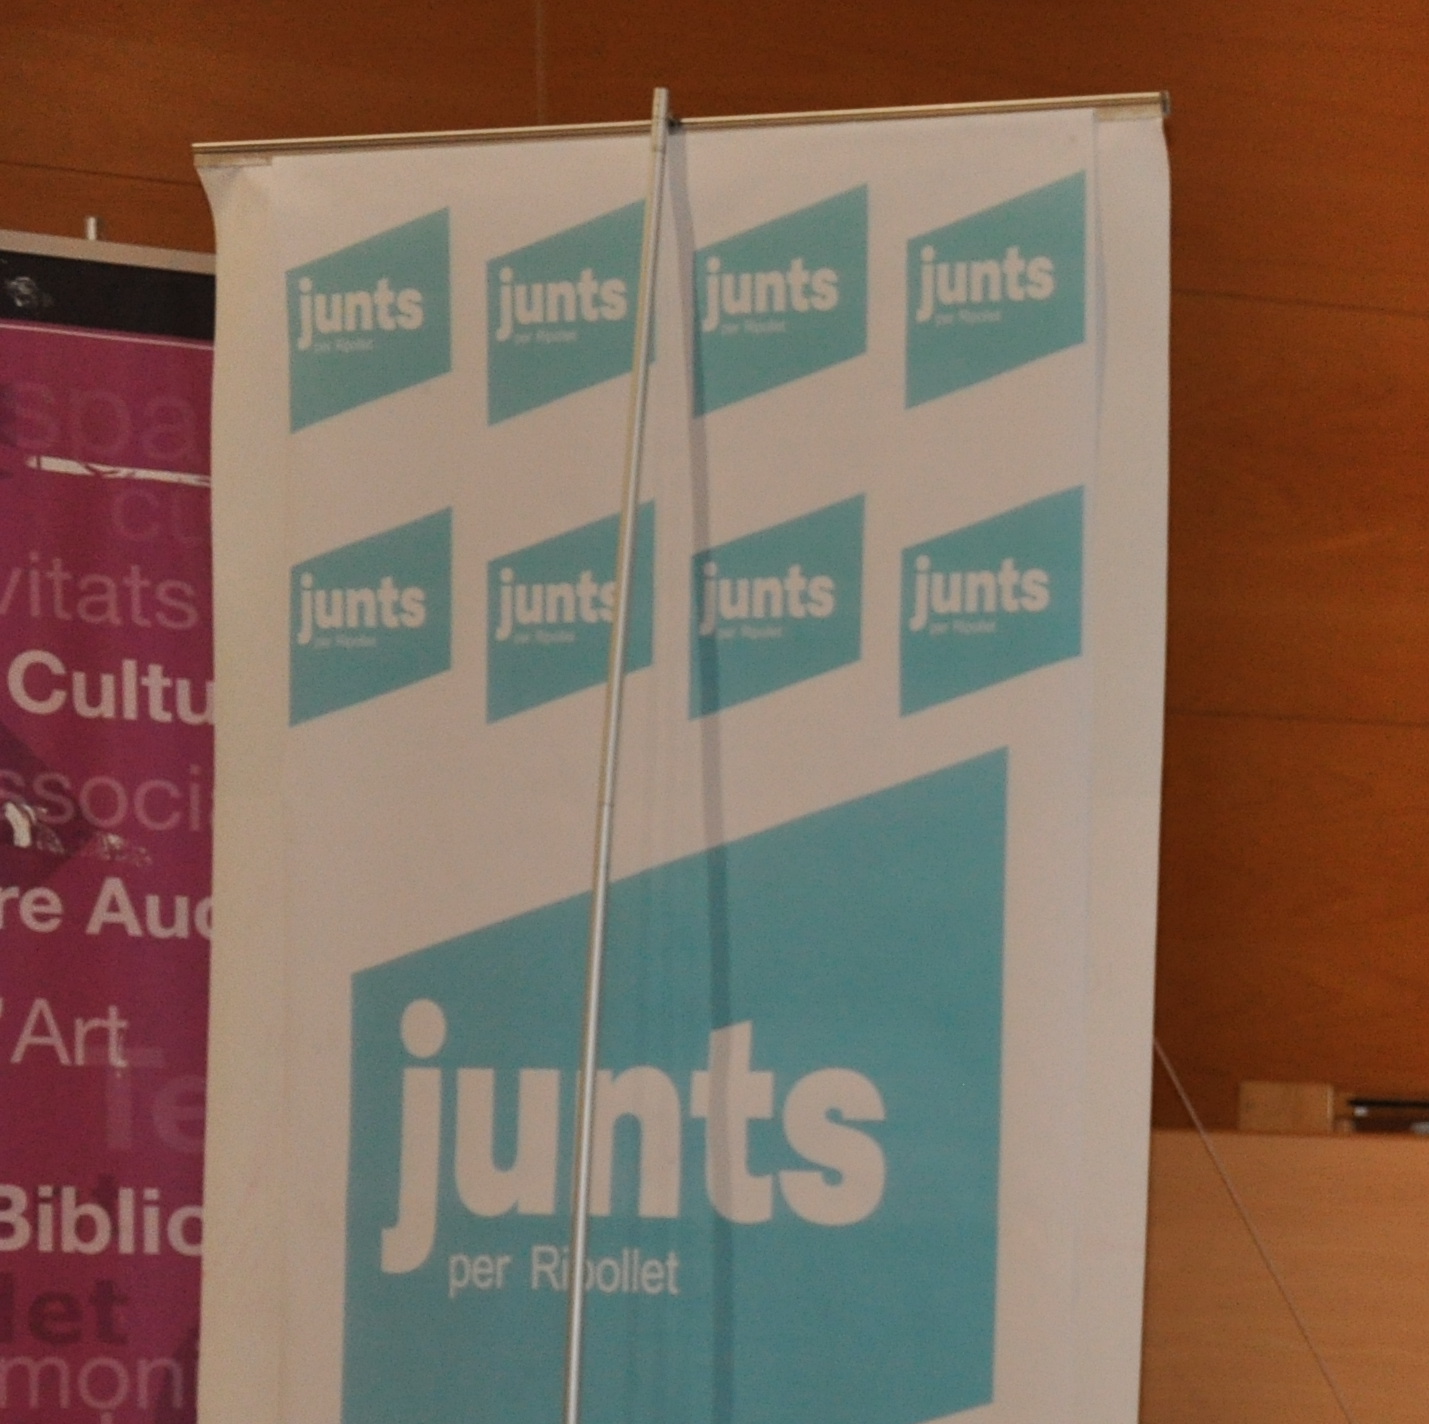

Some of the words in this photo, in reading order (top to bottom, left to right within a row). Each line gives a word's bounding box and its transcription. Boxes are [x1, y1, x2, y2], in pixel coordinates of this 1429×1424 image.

[297, 277, 424, 351] junts
[496, 266, 627, 342] junts
[702, 256, 839, 333] junts
[915, 245, 1056, 323] junts
[297, 573, 427, 645] junts
[699, 562, 835, 636] junts
[909, 555, 1051, 633] junts
[7, 649, 214, 725] Cultu
[380, 999, 887, 1274] junts
[449, 1253, 512, 1299] per
